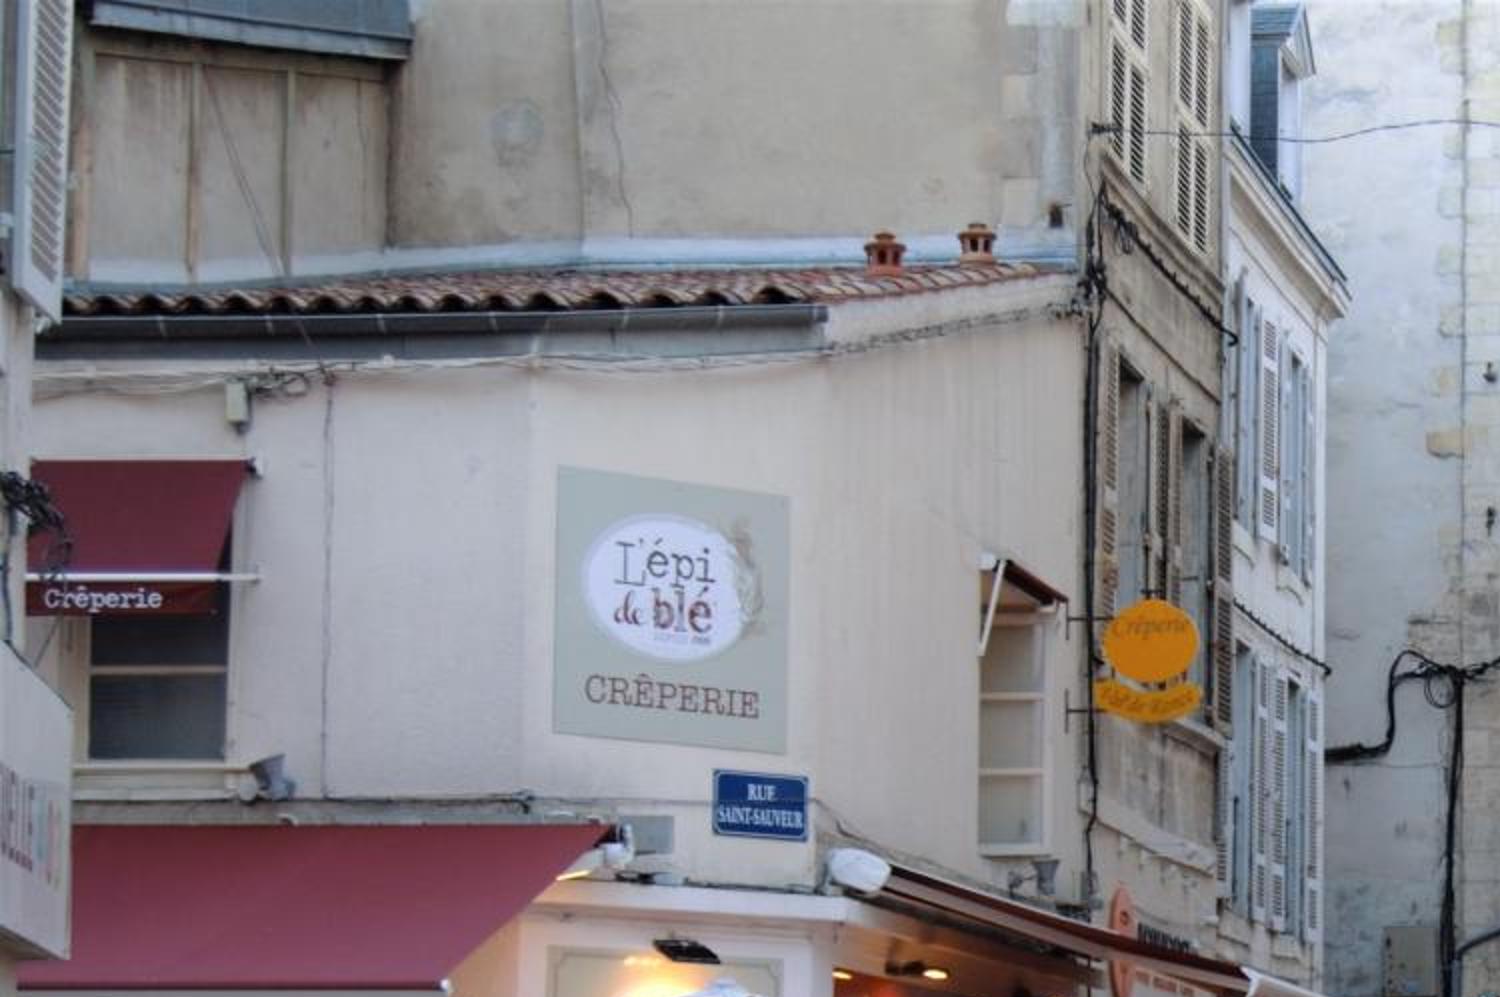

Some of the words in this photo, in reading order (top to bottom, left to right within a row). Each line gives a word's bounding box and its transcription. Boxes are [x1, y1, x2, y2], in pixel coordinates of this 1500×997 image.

[613, 537, 716, 588] L'épi
[44, 585, 163, 613] Crêperie
[613, 590, 641, 626] de
[652, 585, 712, 634] blé
[584, 673, 760, 720] CRÊPERIE
[746, 783, 777, 802] RUE
[719, 804, 803, 829] SAINT-SAUVEUR
